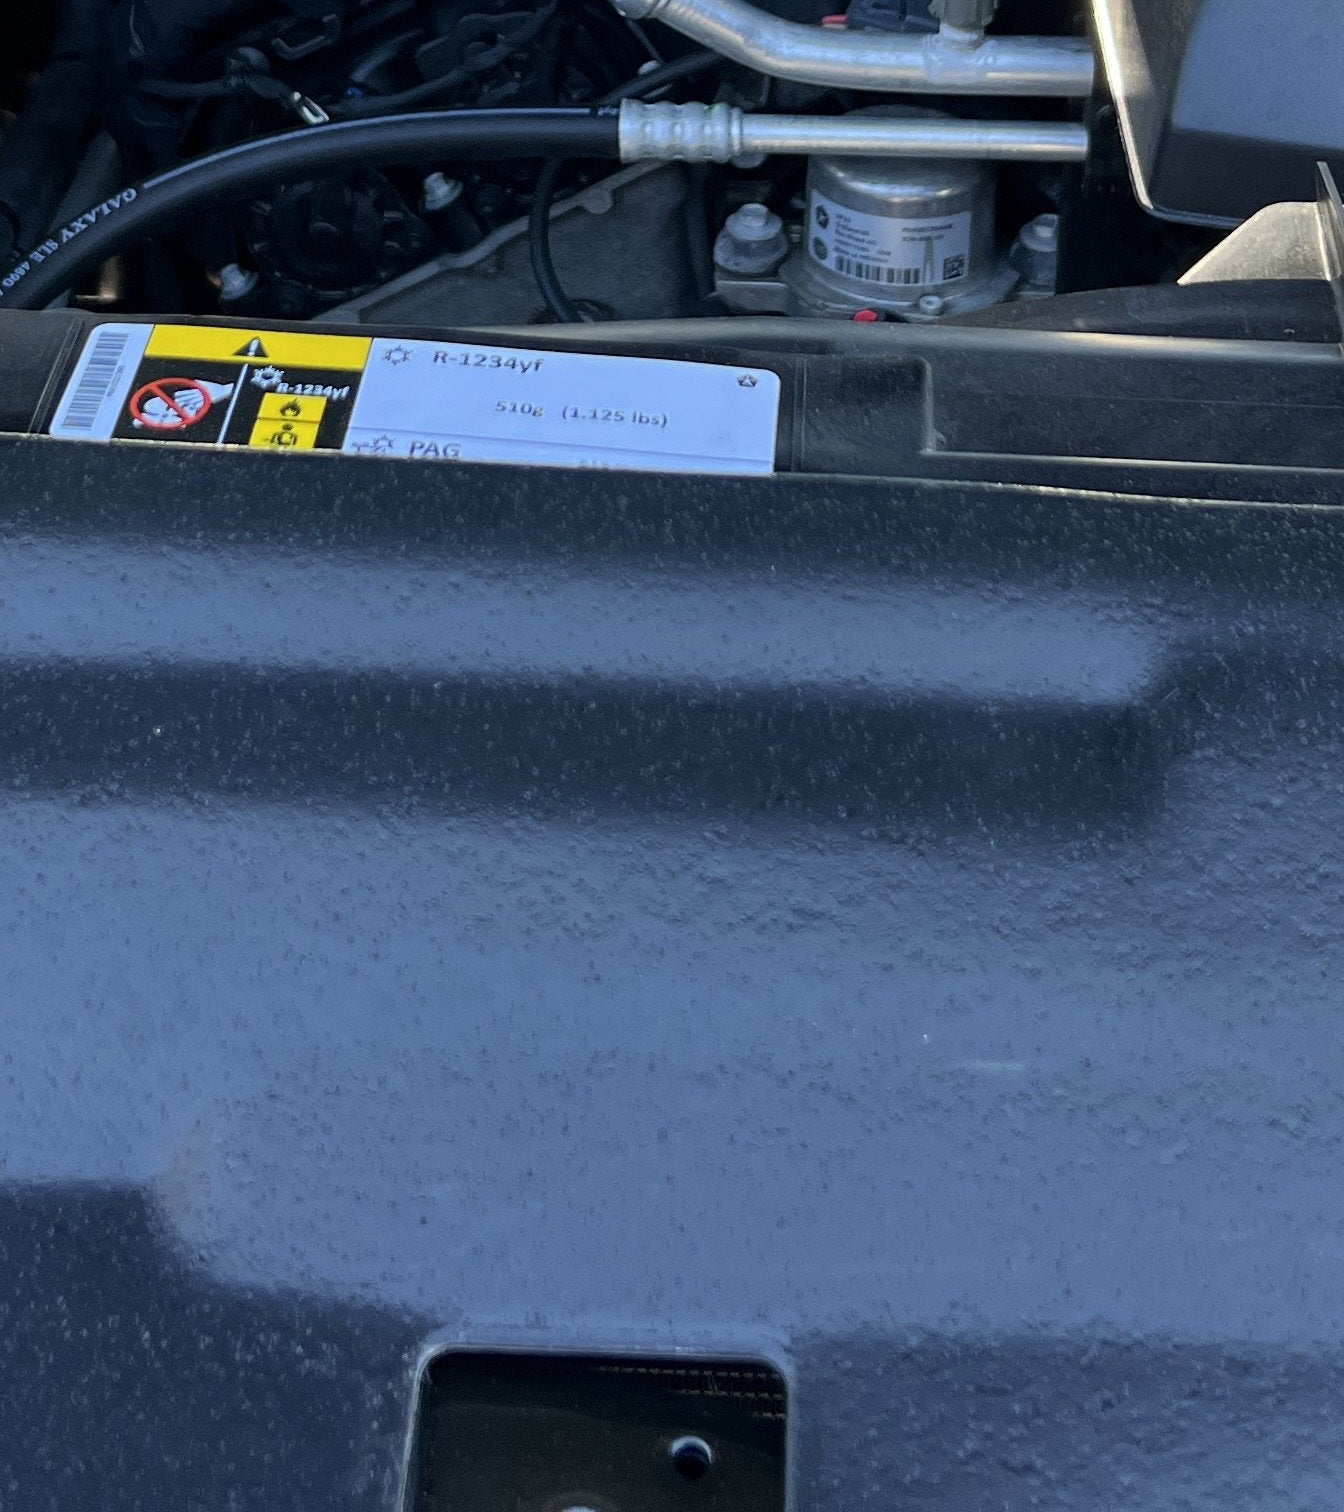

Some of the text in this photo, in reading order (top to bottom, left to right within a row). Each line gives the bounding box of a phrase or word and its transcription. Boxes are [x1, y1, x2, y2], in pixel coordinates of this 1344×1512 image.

[60, 188, 138, 244] GALAXY
[433, 349, 545, 374] R-1234yf
[276, 382, 350, 400] R-1234yf
[495, 400, 668, 428] 510g (1.125 lbs)
[409, 440, 461, 458] PAG
